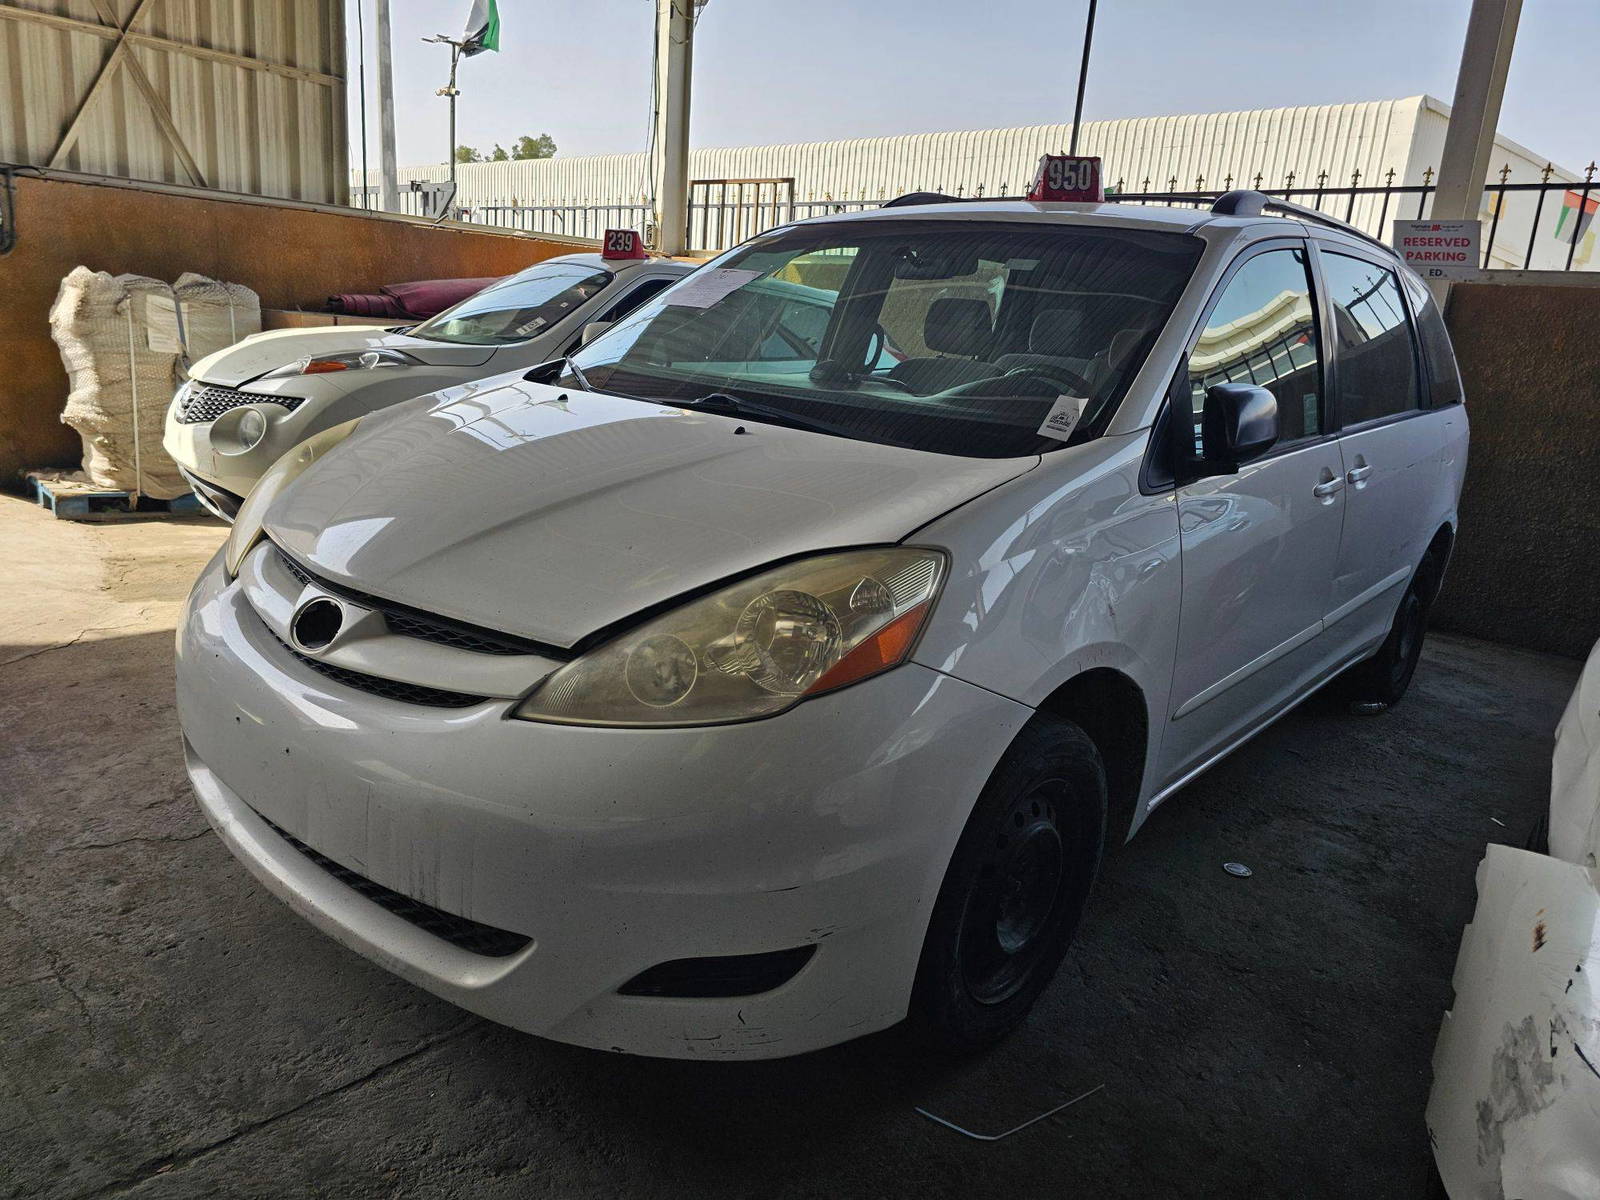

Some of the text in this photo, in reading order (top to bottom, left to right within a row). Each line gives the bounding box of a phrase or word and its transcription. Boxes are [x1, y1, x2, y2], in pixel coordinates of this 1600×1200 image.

[1049, 159, 1091, 190] 950
[608, 232, 632, 251] 239
[1404, 237, 1470, 247] RESERVED
[1406, 251, 1466, 261] PARKING
